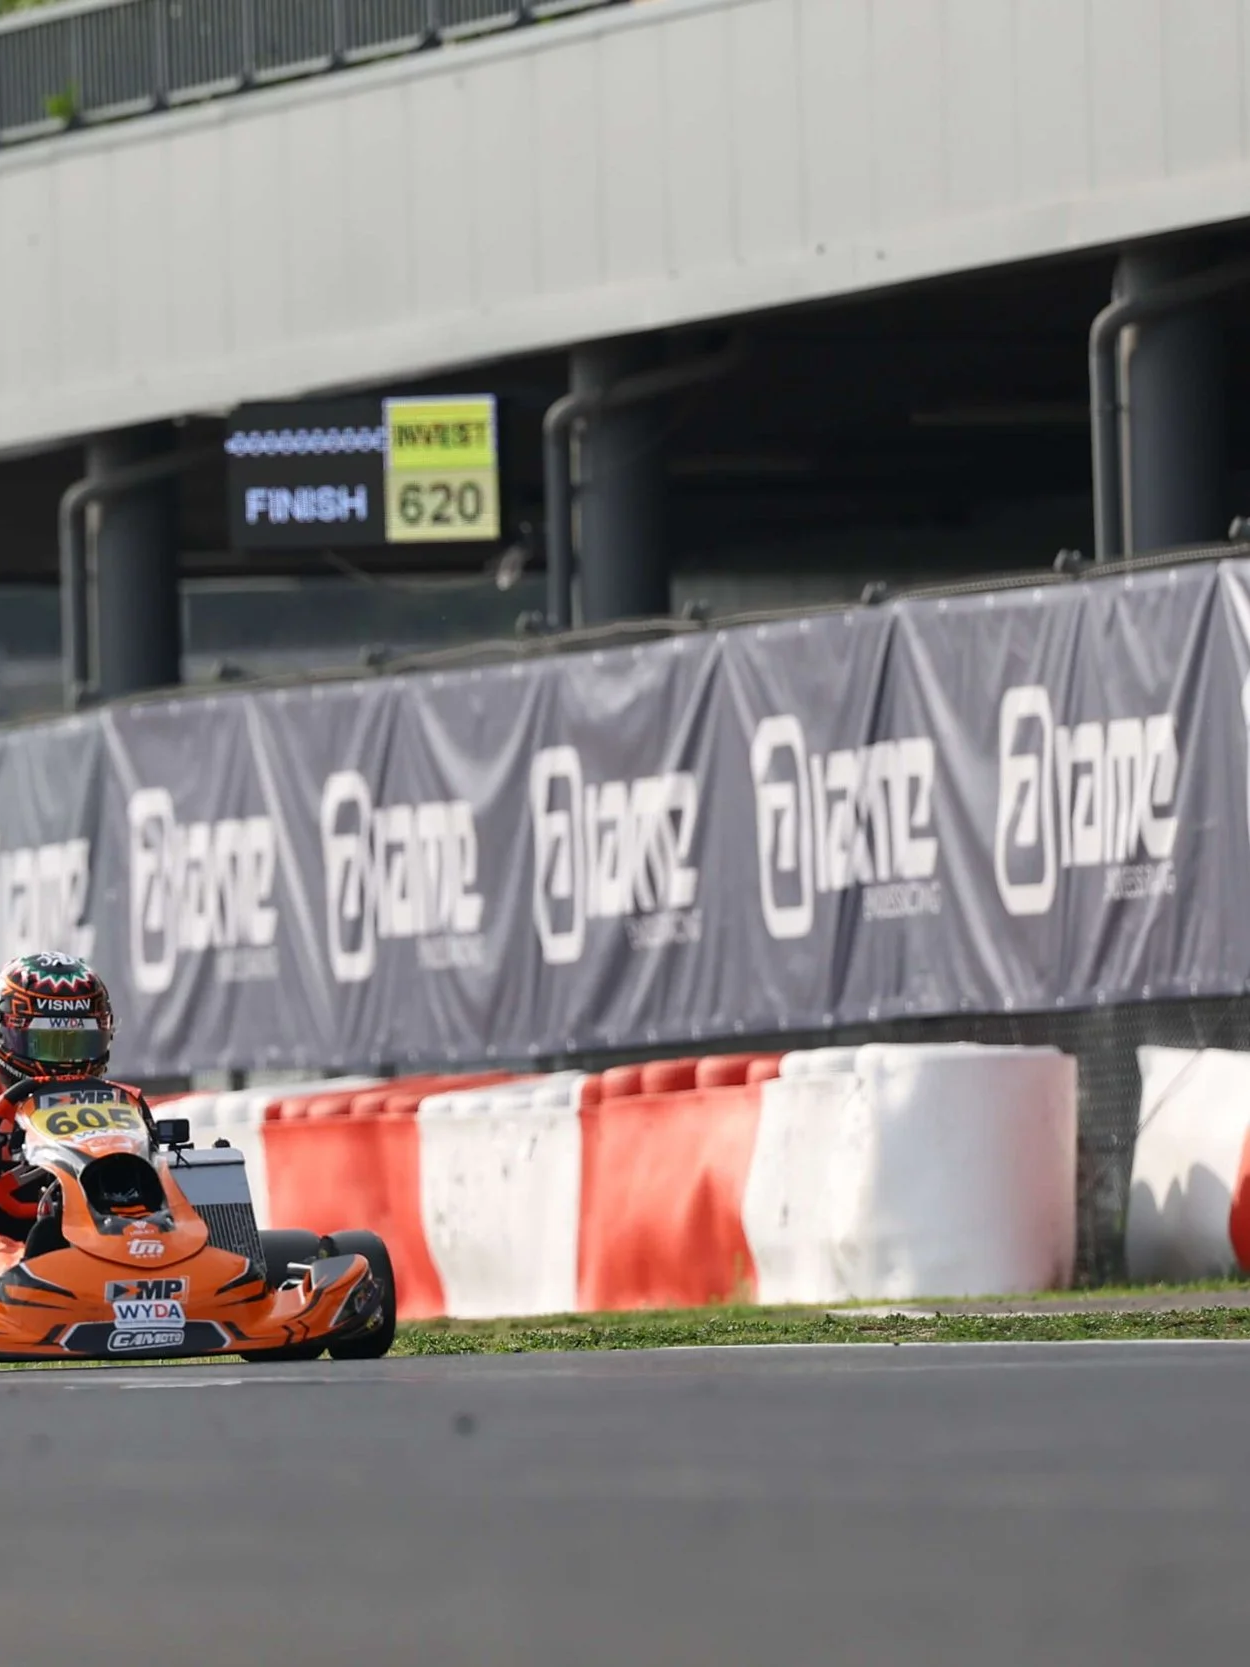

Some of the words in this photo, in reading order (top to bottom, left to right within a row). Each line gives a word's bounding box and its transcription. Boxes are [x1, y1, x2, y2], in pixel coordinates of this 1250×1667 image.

[245, 485, 368, 525] FINISH
[399, 481, 484, 526] 620
[36, 998, 91, 1011] VISNAV
[50, 1018, 85, 1028] WYDA
[46, 1107, 141, 1136] 605
[135, 1279, 184, 1300] MP
[117, 1303, 182, 1319] WYDA
